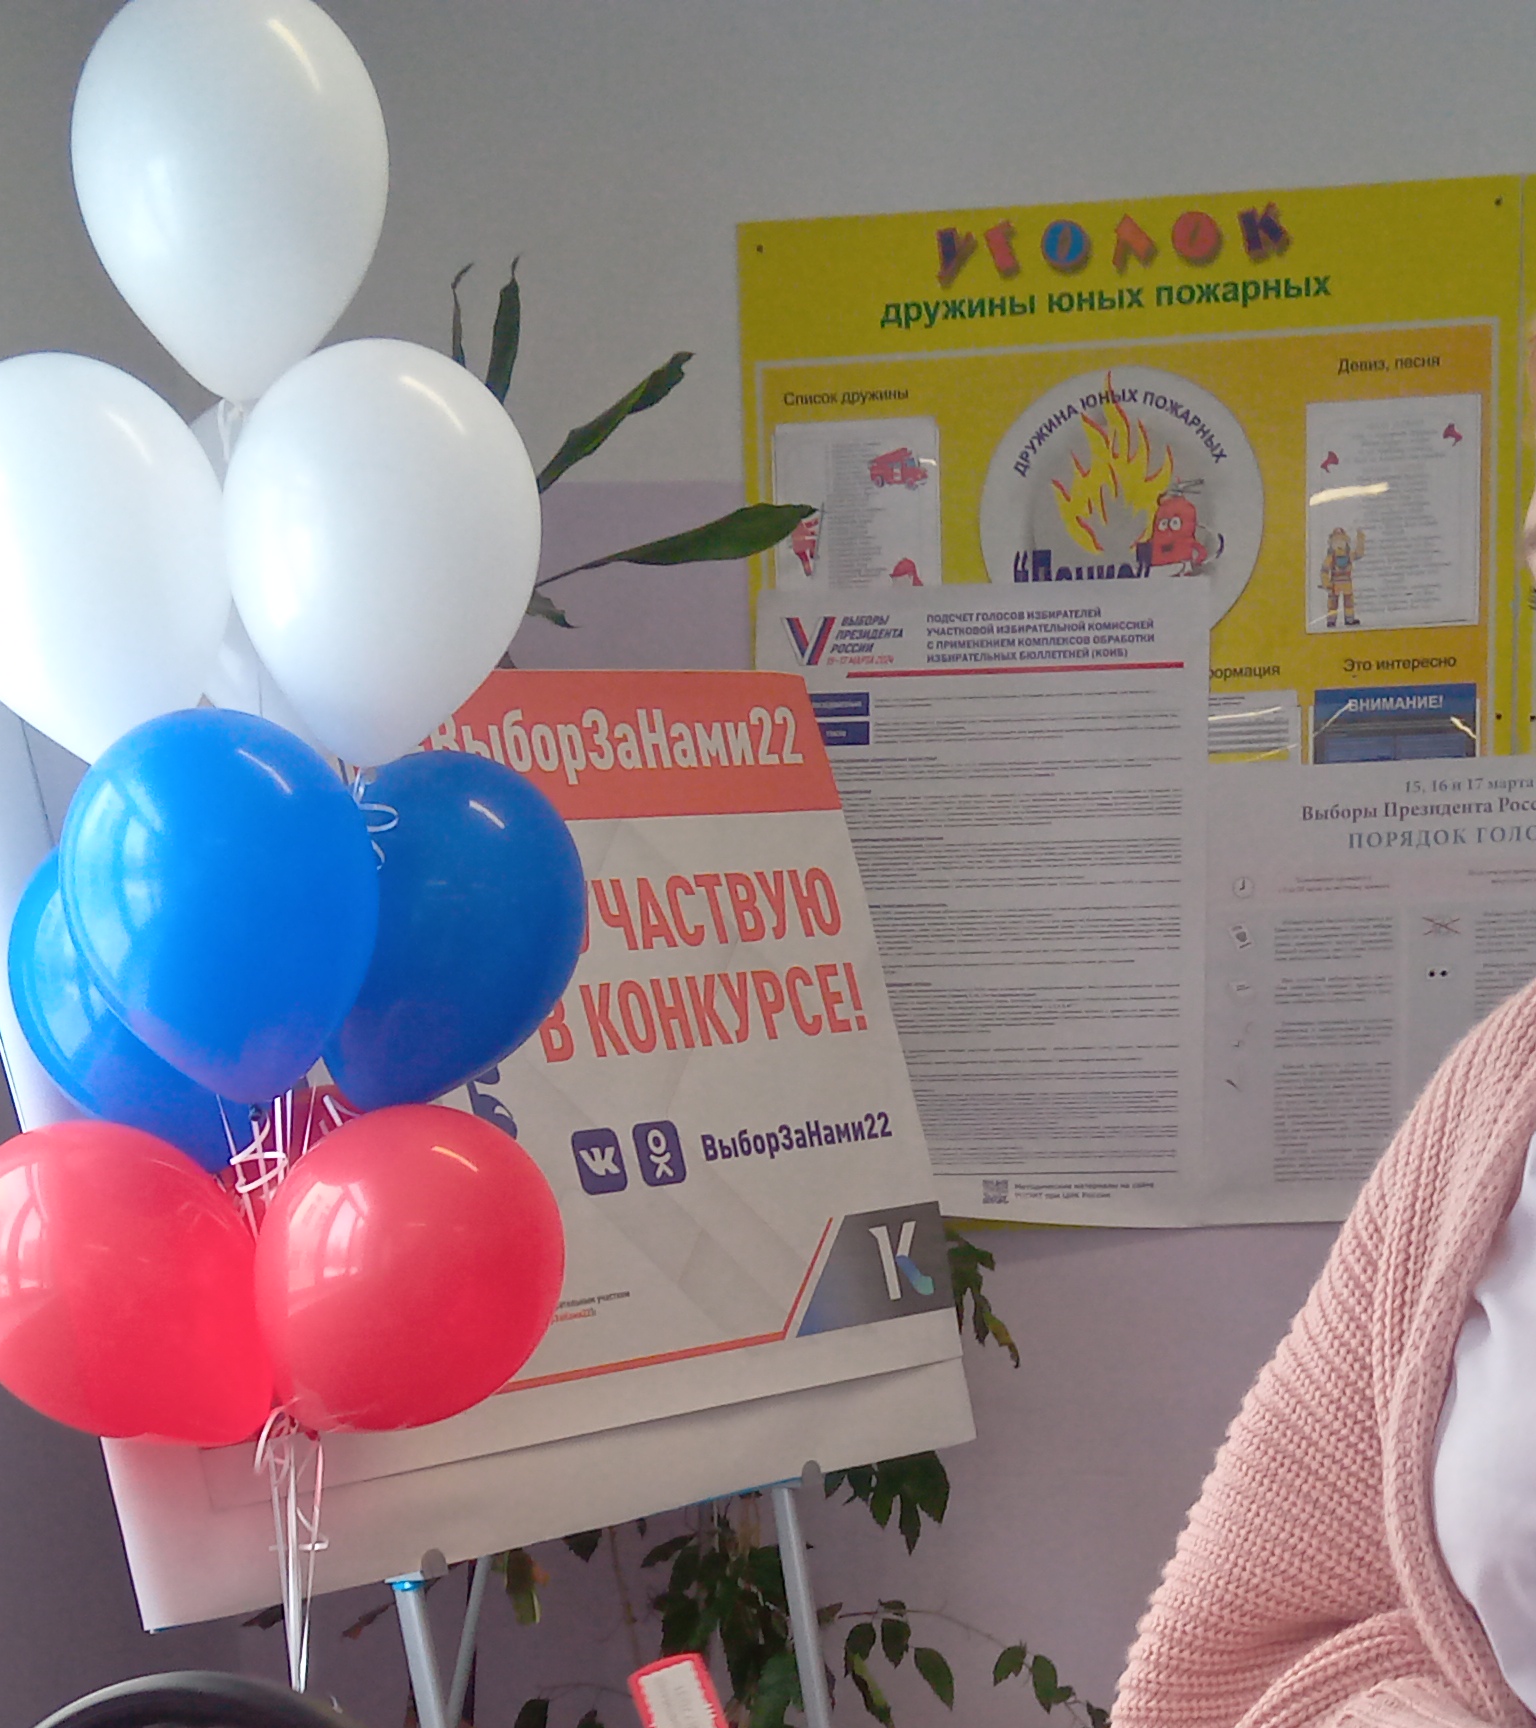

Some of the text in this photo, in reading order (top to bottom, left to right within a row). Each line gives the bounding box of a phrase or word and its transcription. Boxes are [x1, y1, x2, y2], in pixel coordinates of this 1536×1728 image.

[935, 201, 1292, 288] УГОЛОК
[880, 275, 1331, 329] дружины юных пожарных
[784, 389, 909, 406] Список дружины
[1013, 388, 1227, 478] ДРУЖИНА ЮНЫХ ПОЖАРНЫХ
[975, 611, 1025, 621] ГОЛОСОВ
[1027, 606, 1101, 620] ИЗБИРАТЕЛЕЙ
[926, 618, 1154, 636] УЧАСТКОВОЙ ИЗБИРАТЕЛЬНОЙ КОМИССИЕЙ
[936, 639, 1016, 649] ПРИМЕНЕНИЕМ
[1017, 636, 1090, 646] КОМПЛЕКСОВ
[1093, 634, 1155, 644] ОБРАБОТКИ
[926, 651, 1017, 663] ИЗБИРАТЕЛЬНЫХ
[1343, 655, 1457, 673] Это интересно
[1209, 666, 1281, 681] ормация
[1348, 694, 1444, 712] ВНИМАНИЕ!
[417, 705, 803, 785] ВыборЗаНами22
[1432, 779, 1448, 792] 16
[1467, 778, 1484, 790] 17
[1488, 778, 1534, 793] марта
[1301, 803, 1378, 824] Выборы
[1383, 799, 1493, 822] Президента
[1348, 827, 1467, 849] ПОРЯДОК
[579, 962, 868, 1058] КОНКУРСЕ!
[701, 1111, 892, 1161] ВыборЗаНами22
